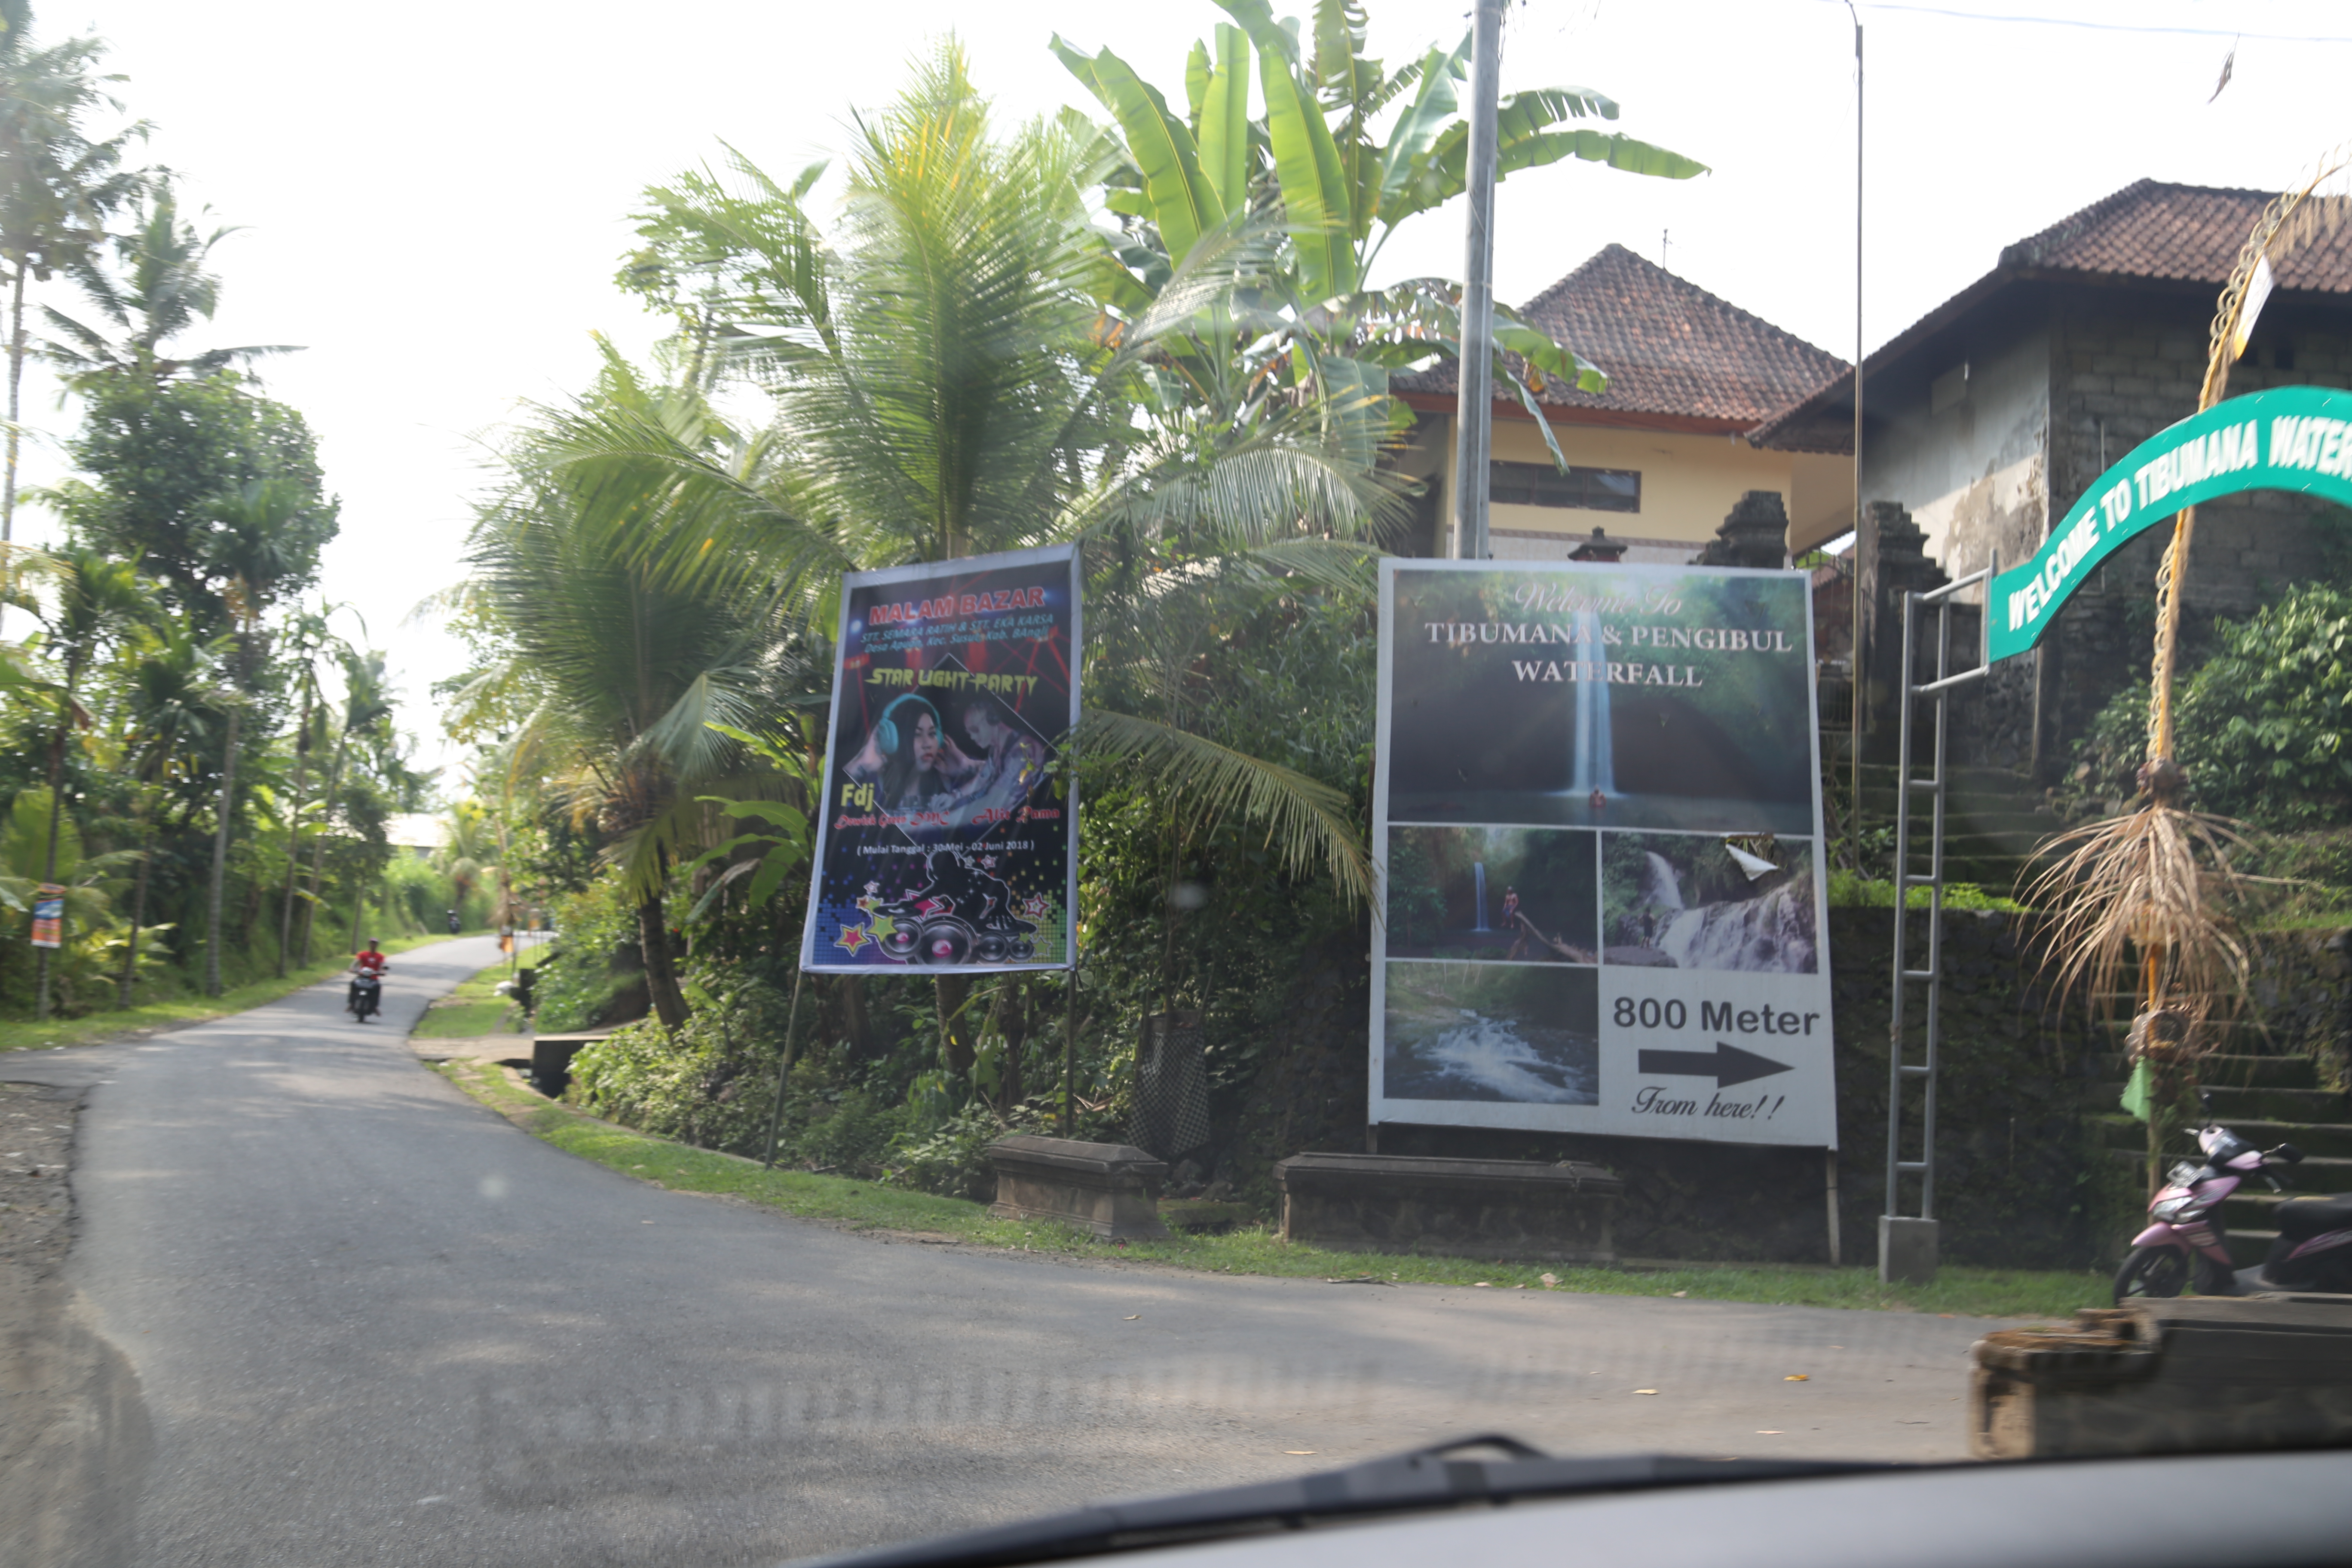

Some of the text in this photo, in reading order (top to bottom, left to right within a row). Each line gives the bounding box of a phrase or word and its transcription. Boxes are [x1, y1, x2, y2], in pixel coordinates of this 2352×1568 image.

[2008, 415, 2352, 632] WELCOME TO TIBUMANA WATER
[869, 586, 1045, 625] MALAM BAZAR
[1514, 582, 1685, 616] Welcome To
[925, 623, 957, 635] RATIH
[958, 622, 967, 632] &
[993, 617, 1014, 628] EKA
[1017, 614, 1053, 627] KARSA
[1424, 622, 1793, 652] TIBUMANA & PENGIBUL
[864, 668, 914, 688] STAR
[968, 673, 1038, 696] PARTY
[1511, 660, 1703, 687] WATERFALL
[841, 783, 875, 812] Fdj
[863, 845, 889, 854] Mulai
[971, 842, 983, 851] 02
[985, 841, 1004, 851] Juni
[1006, 840, 1029, 850] 2018
[1613, 996, 1820, 1036] 800 Meter
[1632, 1086, 1698, 1116] From
